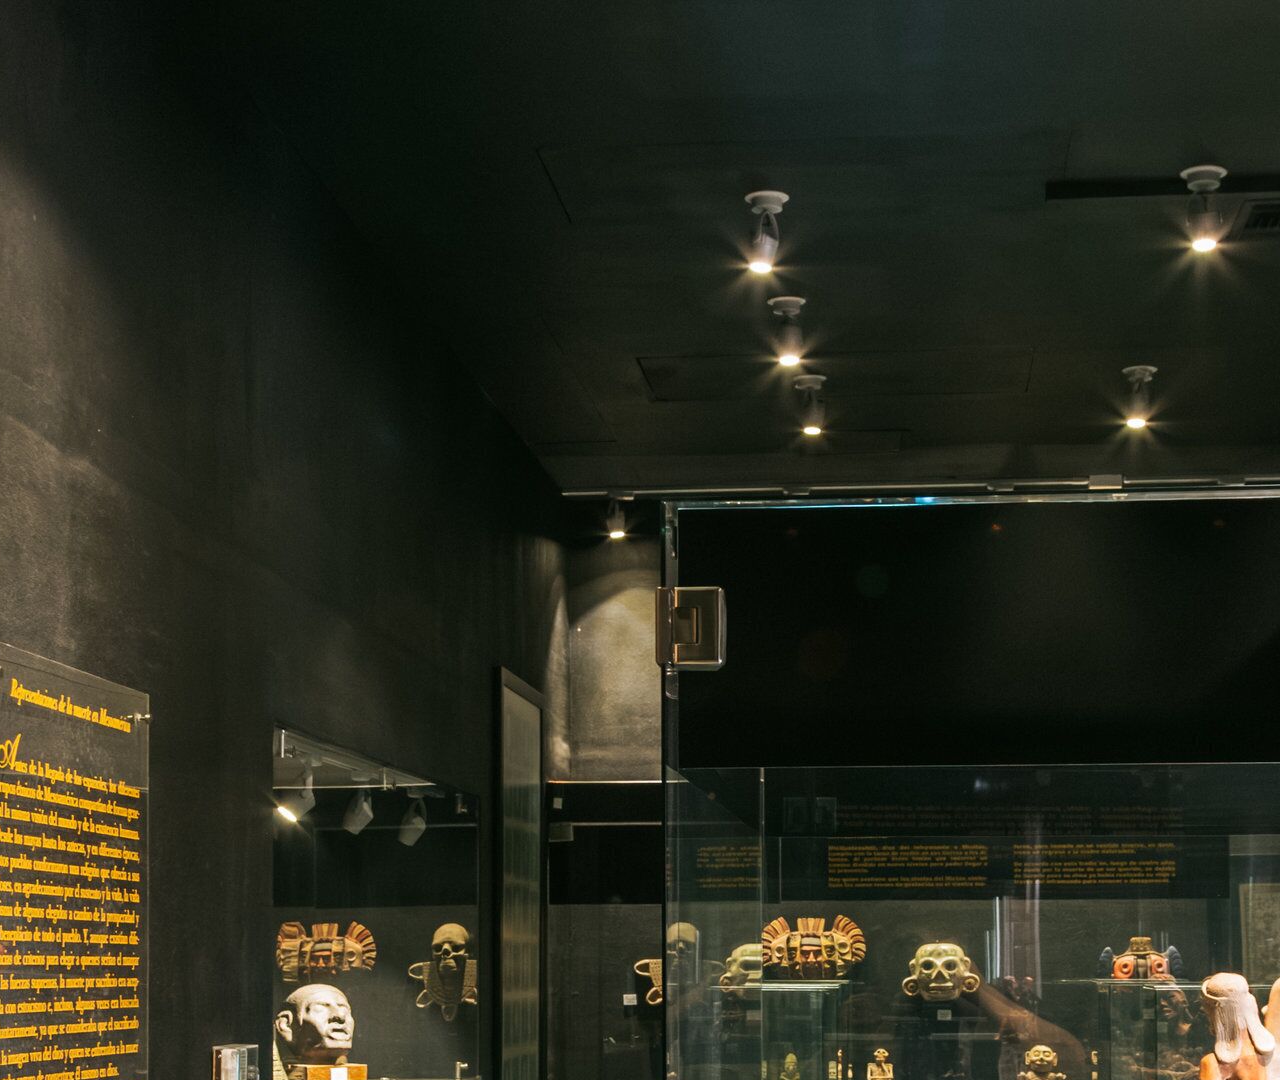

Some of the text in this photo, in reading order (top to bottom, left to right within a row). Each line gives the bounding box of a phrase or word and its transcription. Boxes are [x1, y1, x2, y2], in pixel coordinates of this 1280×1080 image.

[57, 694, 66, 713] de
[65, 697, 74, 716] la
[91, 711, 100, 724] en
